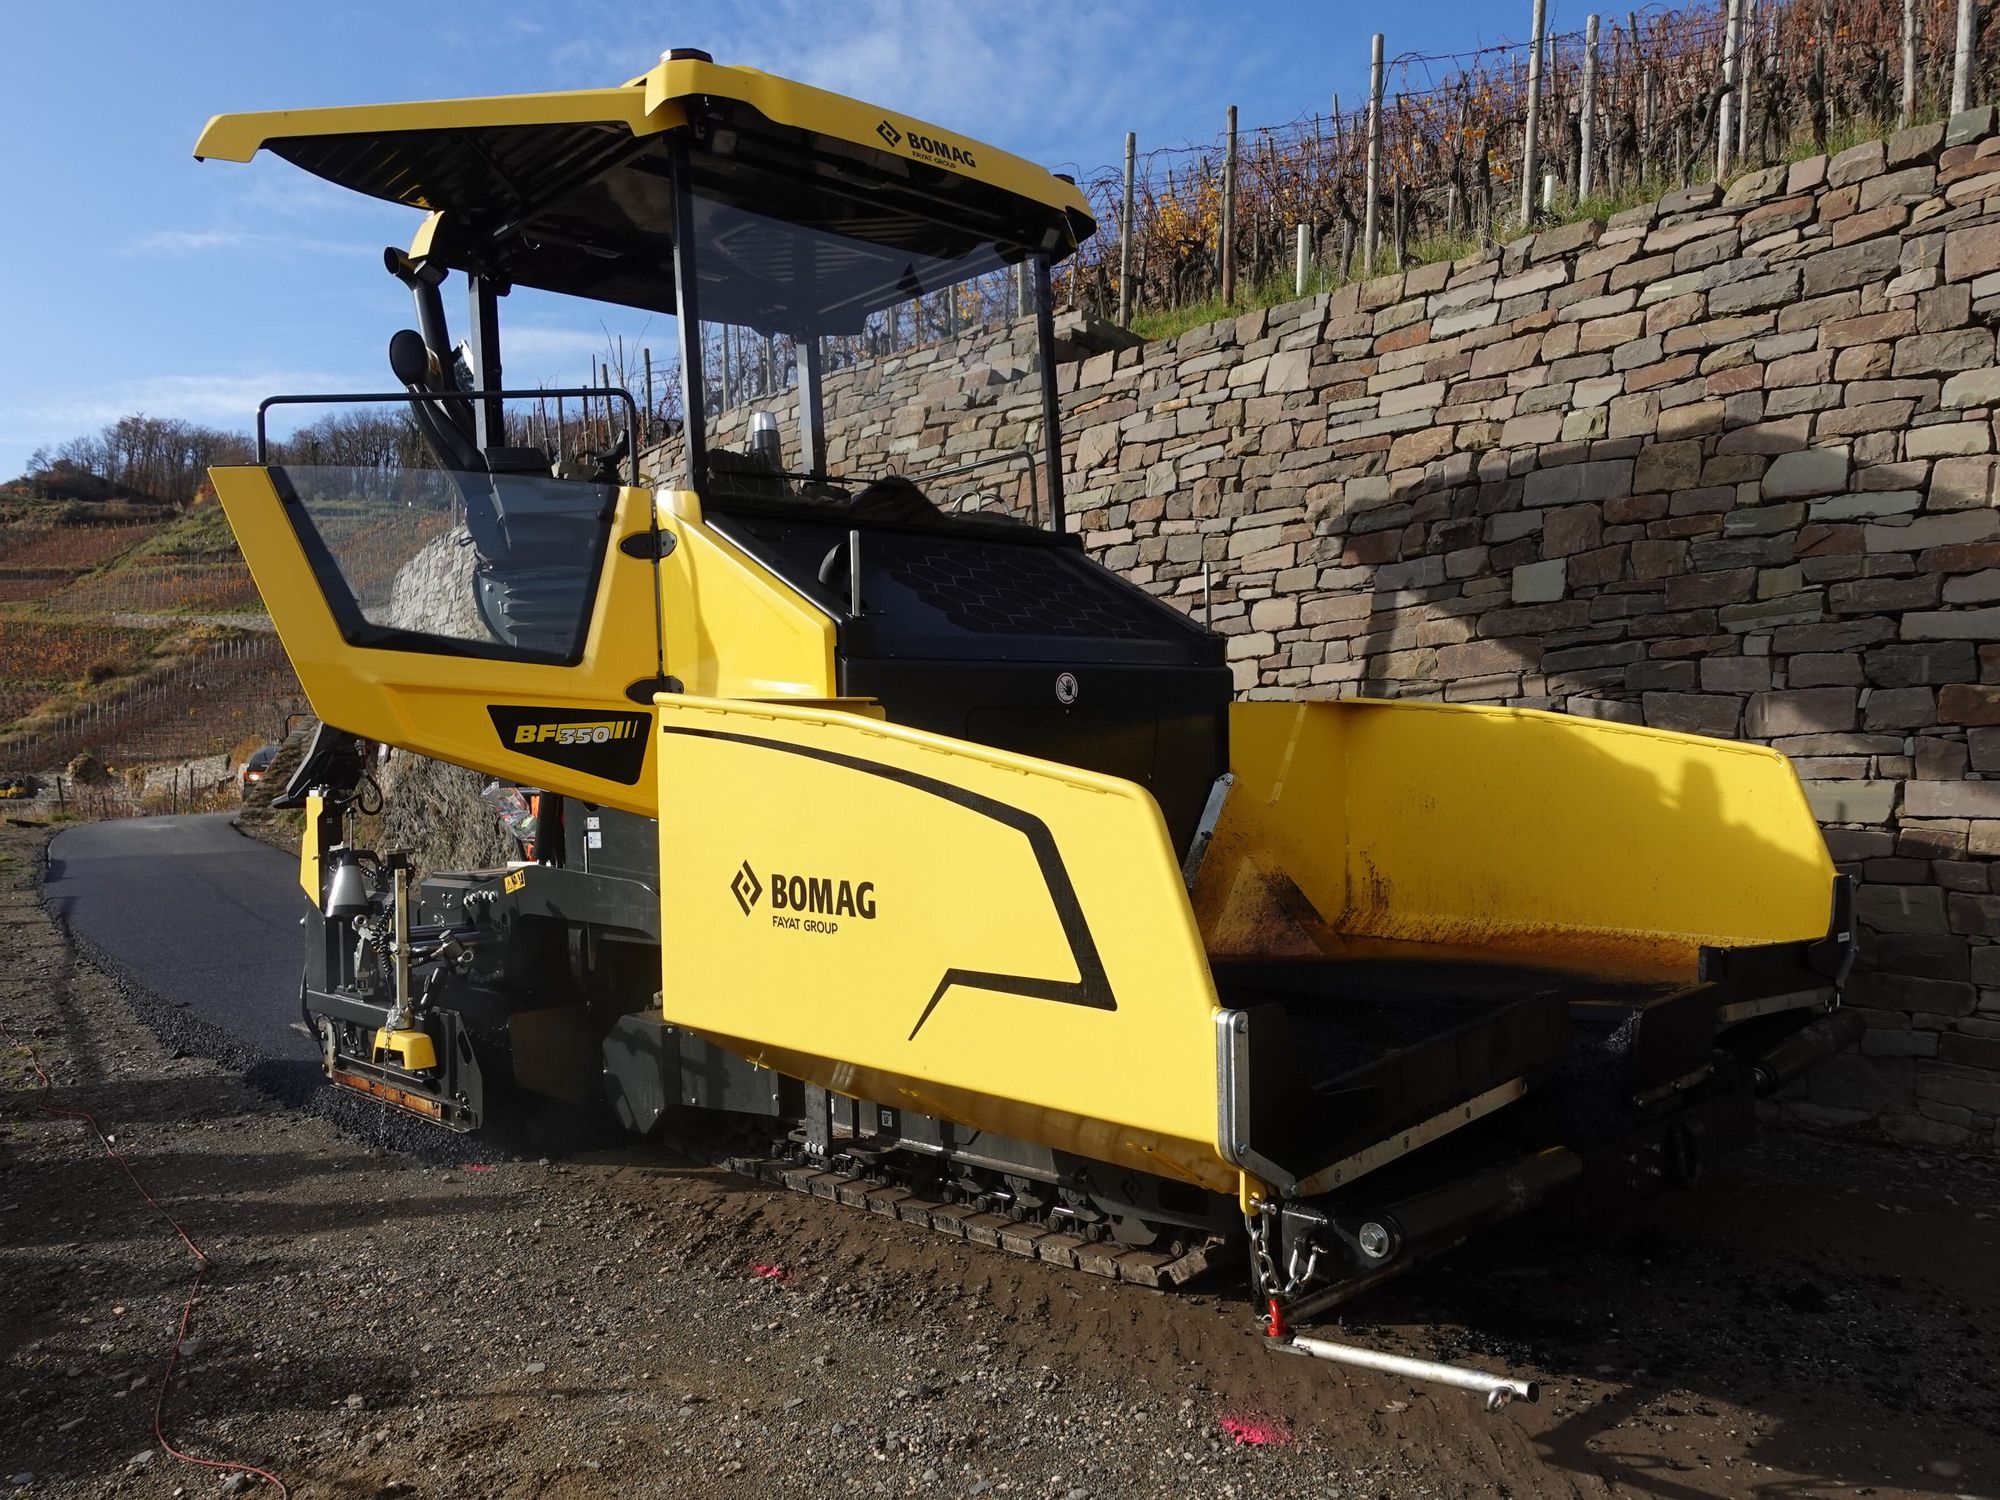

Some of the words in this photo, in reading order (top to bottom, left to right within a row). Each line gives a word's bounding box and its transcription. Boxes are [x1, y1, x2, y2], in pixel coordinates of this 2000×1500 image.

[906, 131, 976, 168] BOMAG
[912, 150, 933, 161] FAYAT
[934, 157, 957, 169] GROUP
[771, 873, 876, 920] BOMAG
[772, 915, 800, 930] FAYAT
[803, 919, 838, 935] GROUP
